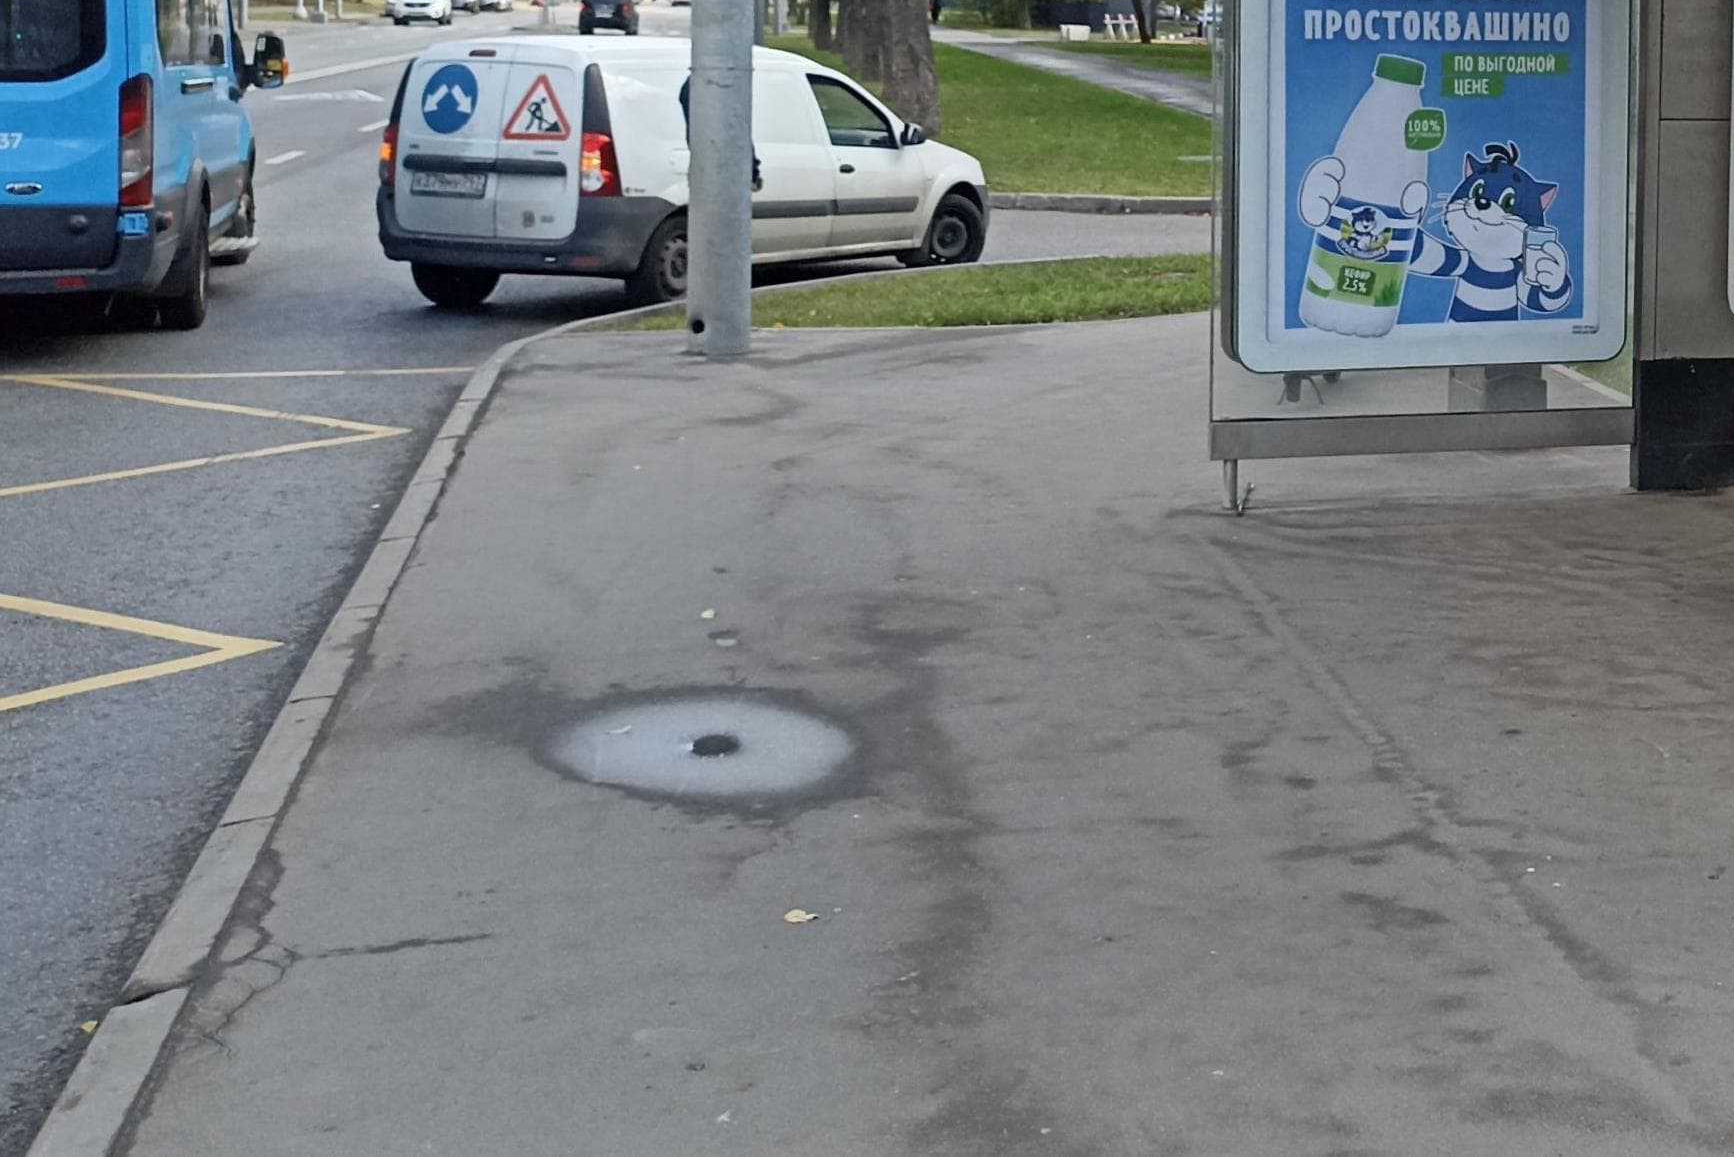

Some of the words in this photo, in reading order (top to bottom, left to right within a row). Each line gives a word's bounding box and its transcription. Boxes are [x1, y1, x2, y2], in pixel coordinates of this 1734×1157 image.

[1304, 9, 1570, 42] ПРОСТОКВАШИНО
[1454, 55, 1472, 72] ПО
[1478, 54, 1556, 74] ВЫГОДНОЙ
[1454, 78, 1490, 96] ЦЕНЕ
[1408, 120, 1441, 132] 100%
